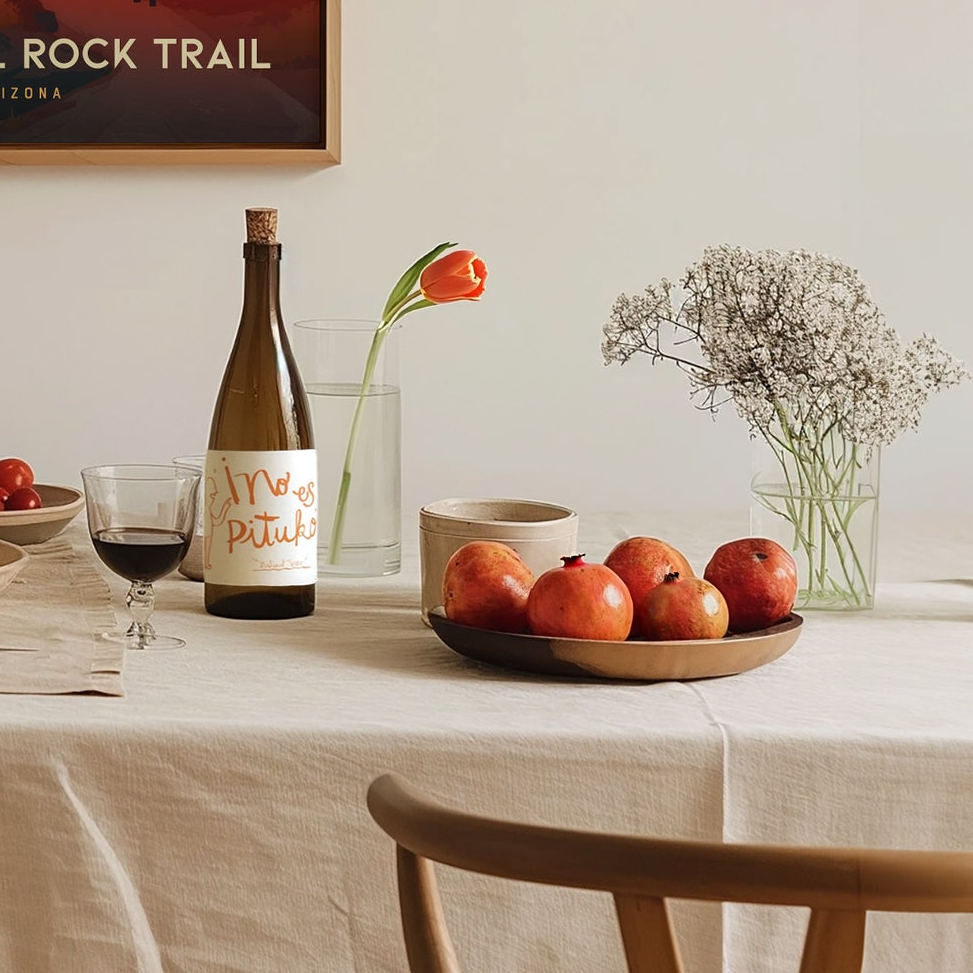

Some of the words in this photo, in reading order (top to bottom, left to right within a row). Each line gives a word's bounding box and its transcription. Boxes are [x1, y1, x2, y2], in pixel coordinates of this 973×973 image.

[23, 37, 138, 69] ROCK
[153, 37, 271, 69] TRAIL
[292, 481, 315, 507] es
